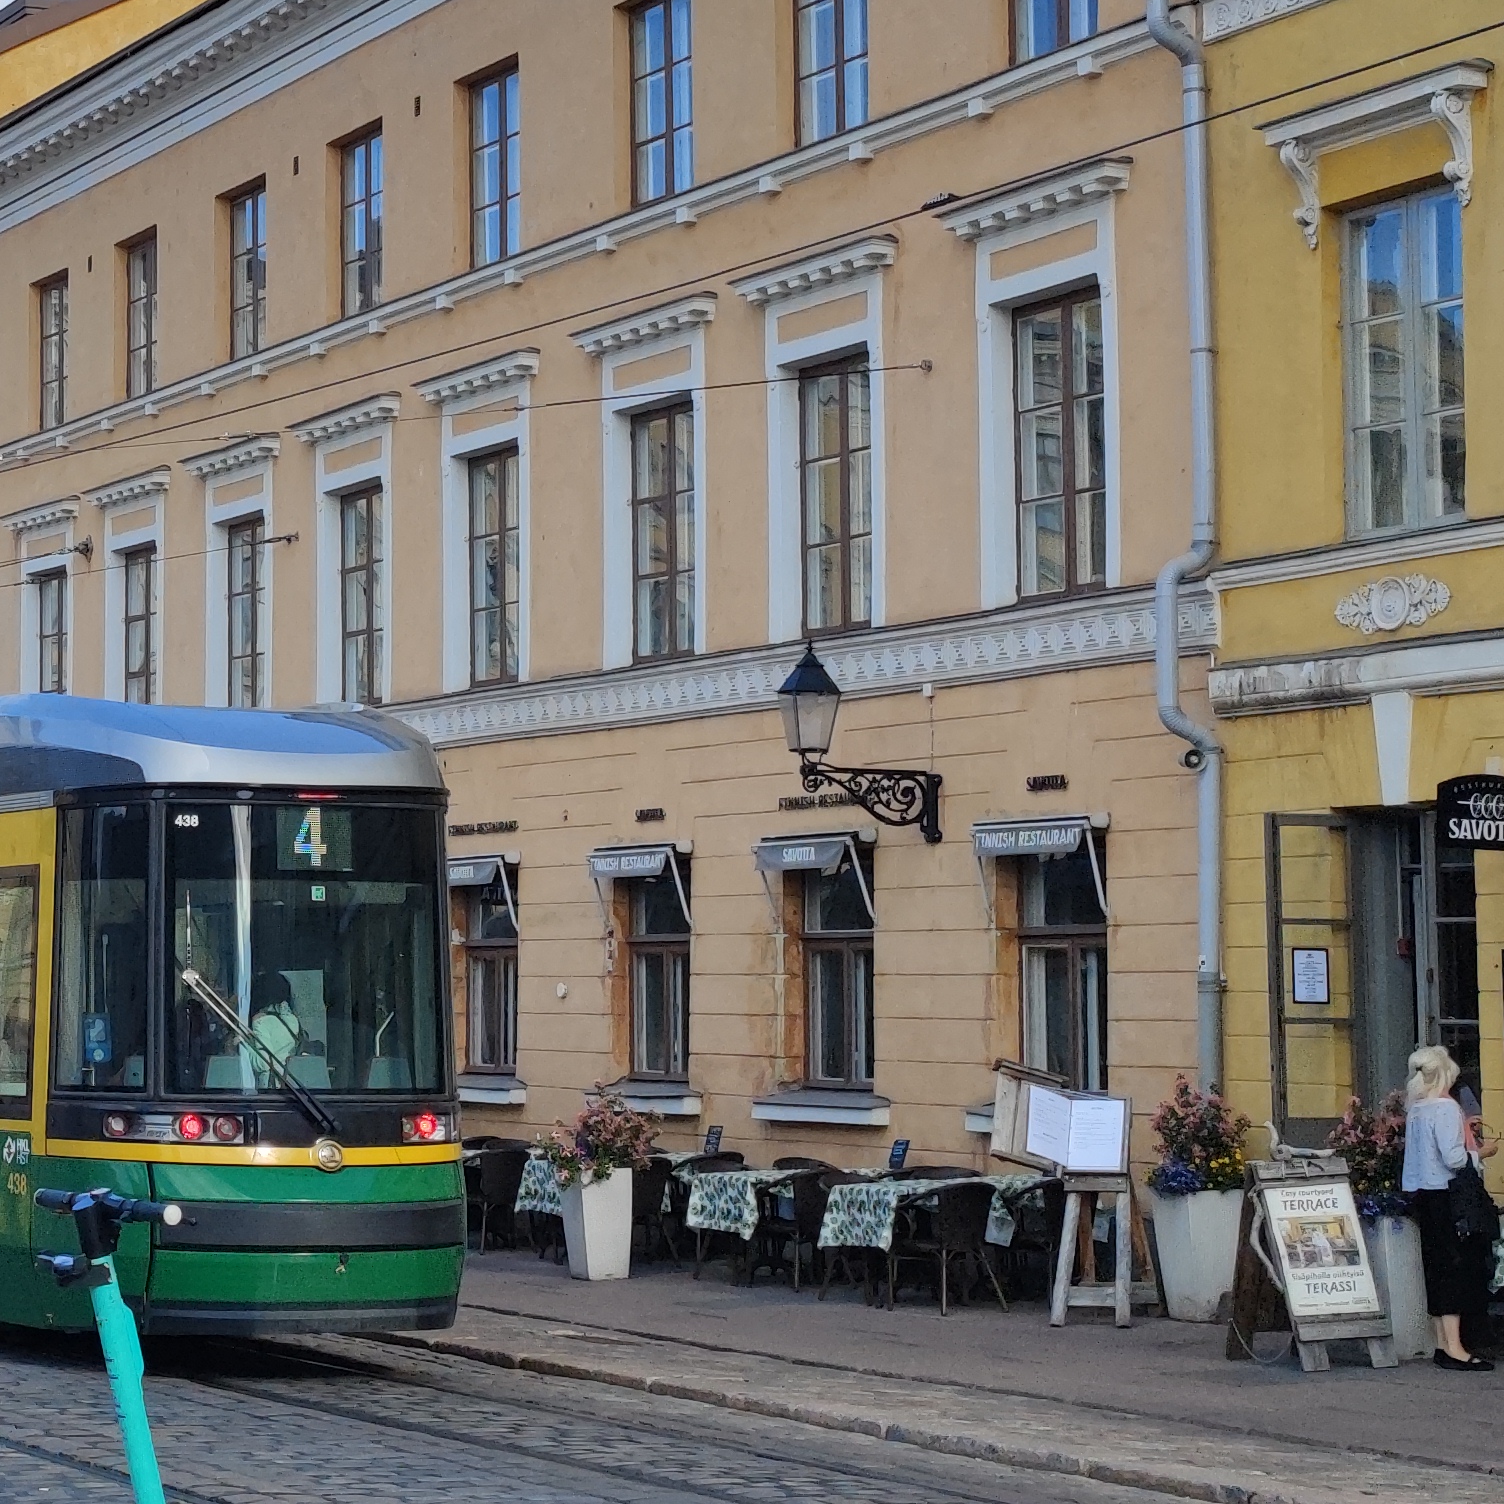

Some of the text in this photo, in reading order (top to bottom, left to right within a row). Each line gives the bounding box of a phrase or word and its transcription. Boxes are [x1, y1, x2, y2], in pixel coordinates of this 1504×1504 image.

[174, 814, 200, 828] 438
[294, 806, 327, 867] 4
[1018, 827, 1083, 847] RESTAURANT
[782, 846, 816, 863] SAVOTTA
[7, 1172, 28, 1196] 438
[1281, 1197, 1339, 1212] TERRACE
[1305, 1280, 1357, 1295] TERASSI
